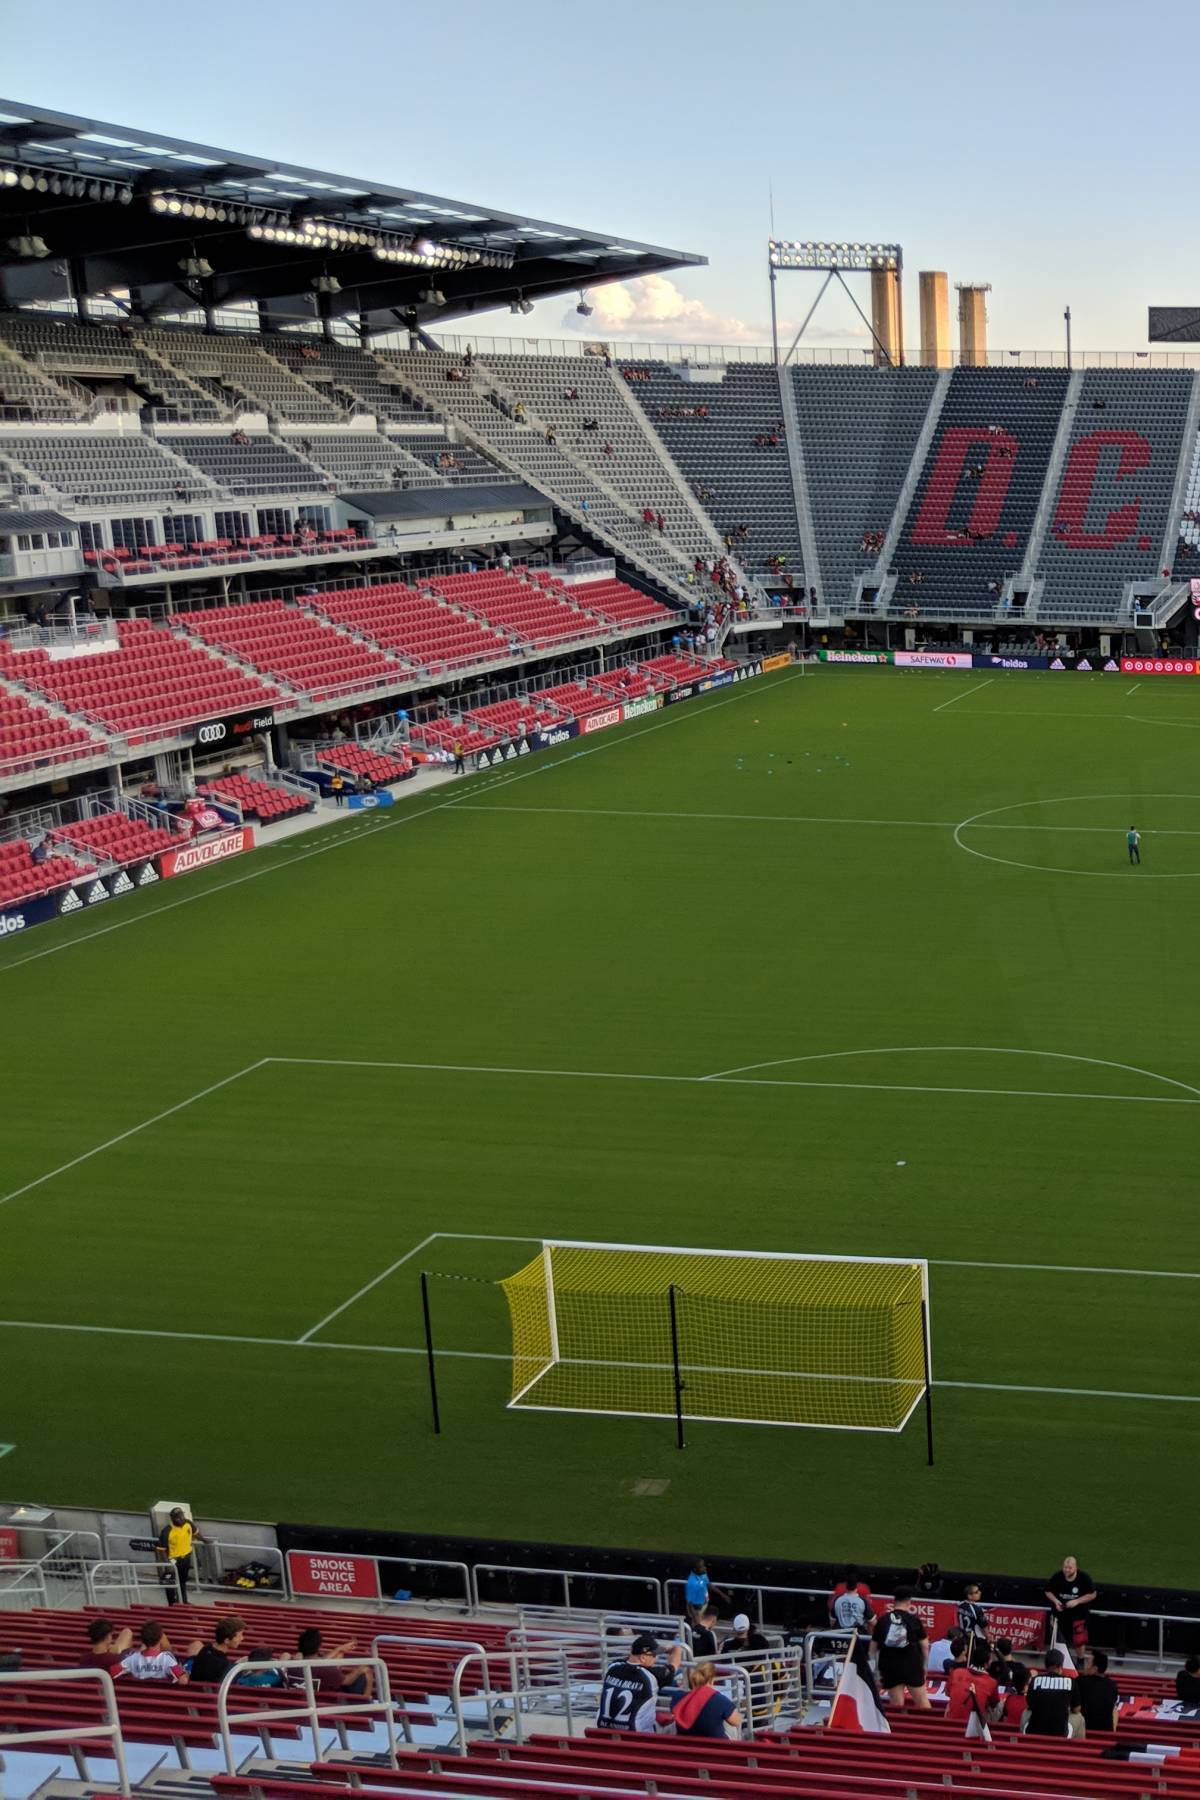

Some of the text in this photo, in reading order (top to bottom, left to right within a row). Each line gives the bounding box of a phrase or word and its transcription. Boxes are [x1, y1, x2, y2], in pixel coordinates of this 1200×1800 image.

[826, 650, 878, 663] Heineken
[910, 655, 945, 665] SAFEWAY
[1002, 658, 1028, 669] leidos
[623, 699, 657, 720] Heineken
[253, 715, 273, 729] Field
[586, 711, 620, 733] ADVOCARE
[549, 730, 570, 745] leidos
[173, 831, 244, 873] ADVOCARE
[139, 873, 159, 886] adidas
[114, 881, 135, 895] adidas
[88, 890, 110, 904] adidas
[61, 900, 84, 913] adidas
[310, 1558, 355, 1571] SMOKE
[311, 1570, 357, 1582] DEVICE
[318, 1582, 353, 1593] AREA
[886, 1603, 936, 1616] SOKE
[996, 1616, 1009, 1625] BE
[1011, 1617, 1042, 1629] ALERT!
[989, 1626, 1009, 1636] MAY
[830, 1640, 849, 1649] 136
[1033, 1676, 1073, 1691] PUMA
[602, 1687, 634, 1722] 12
